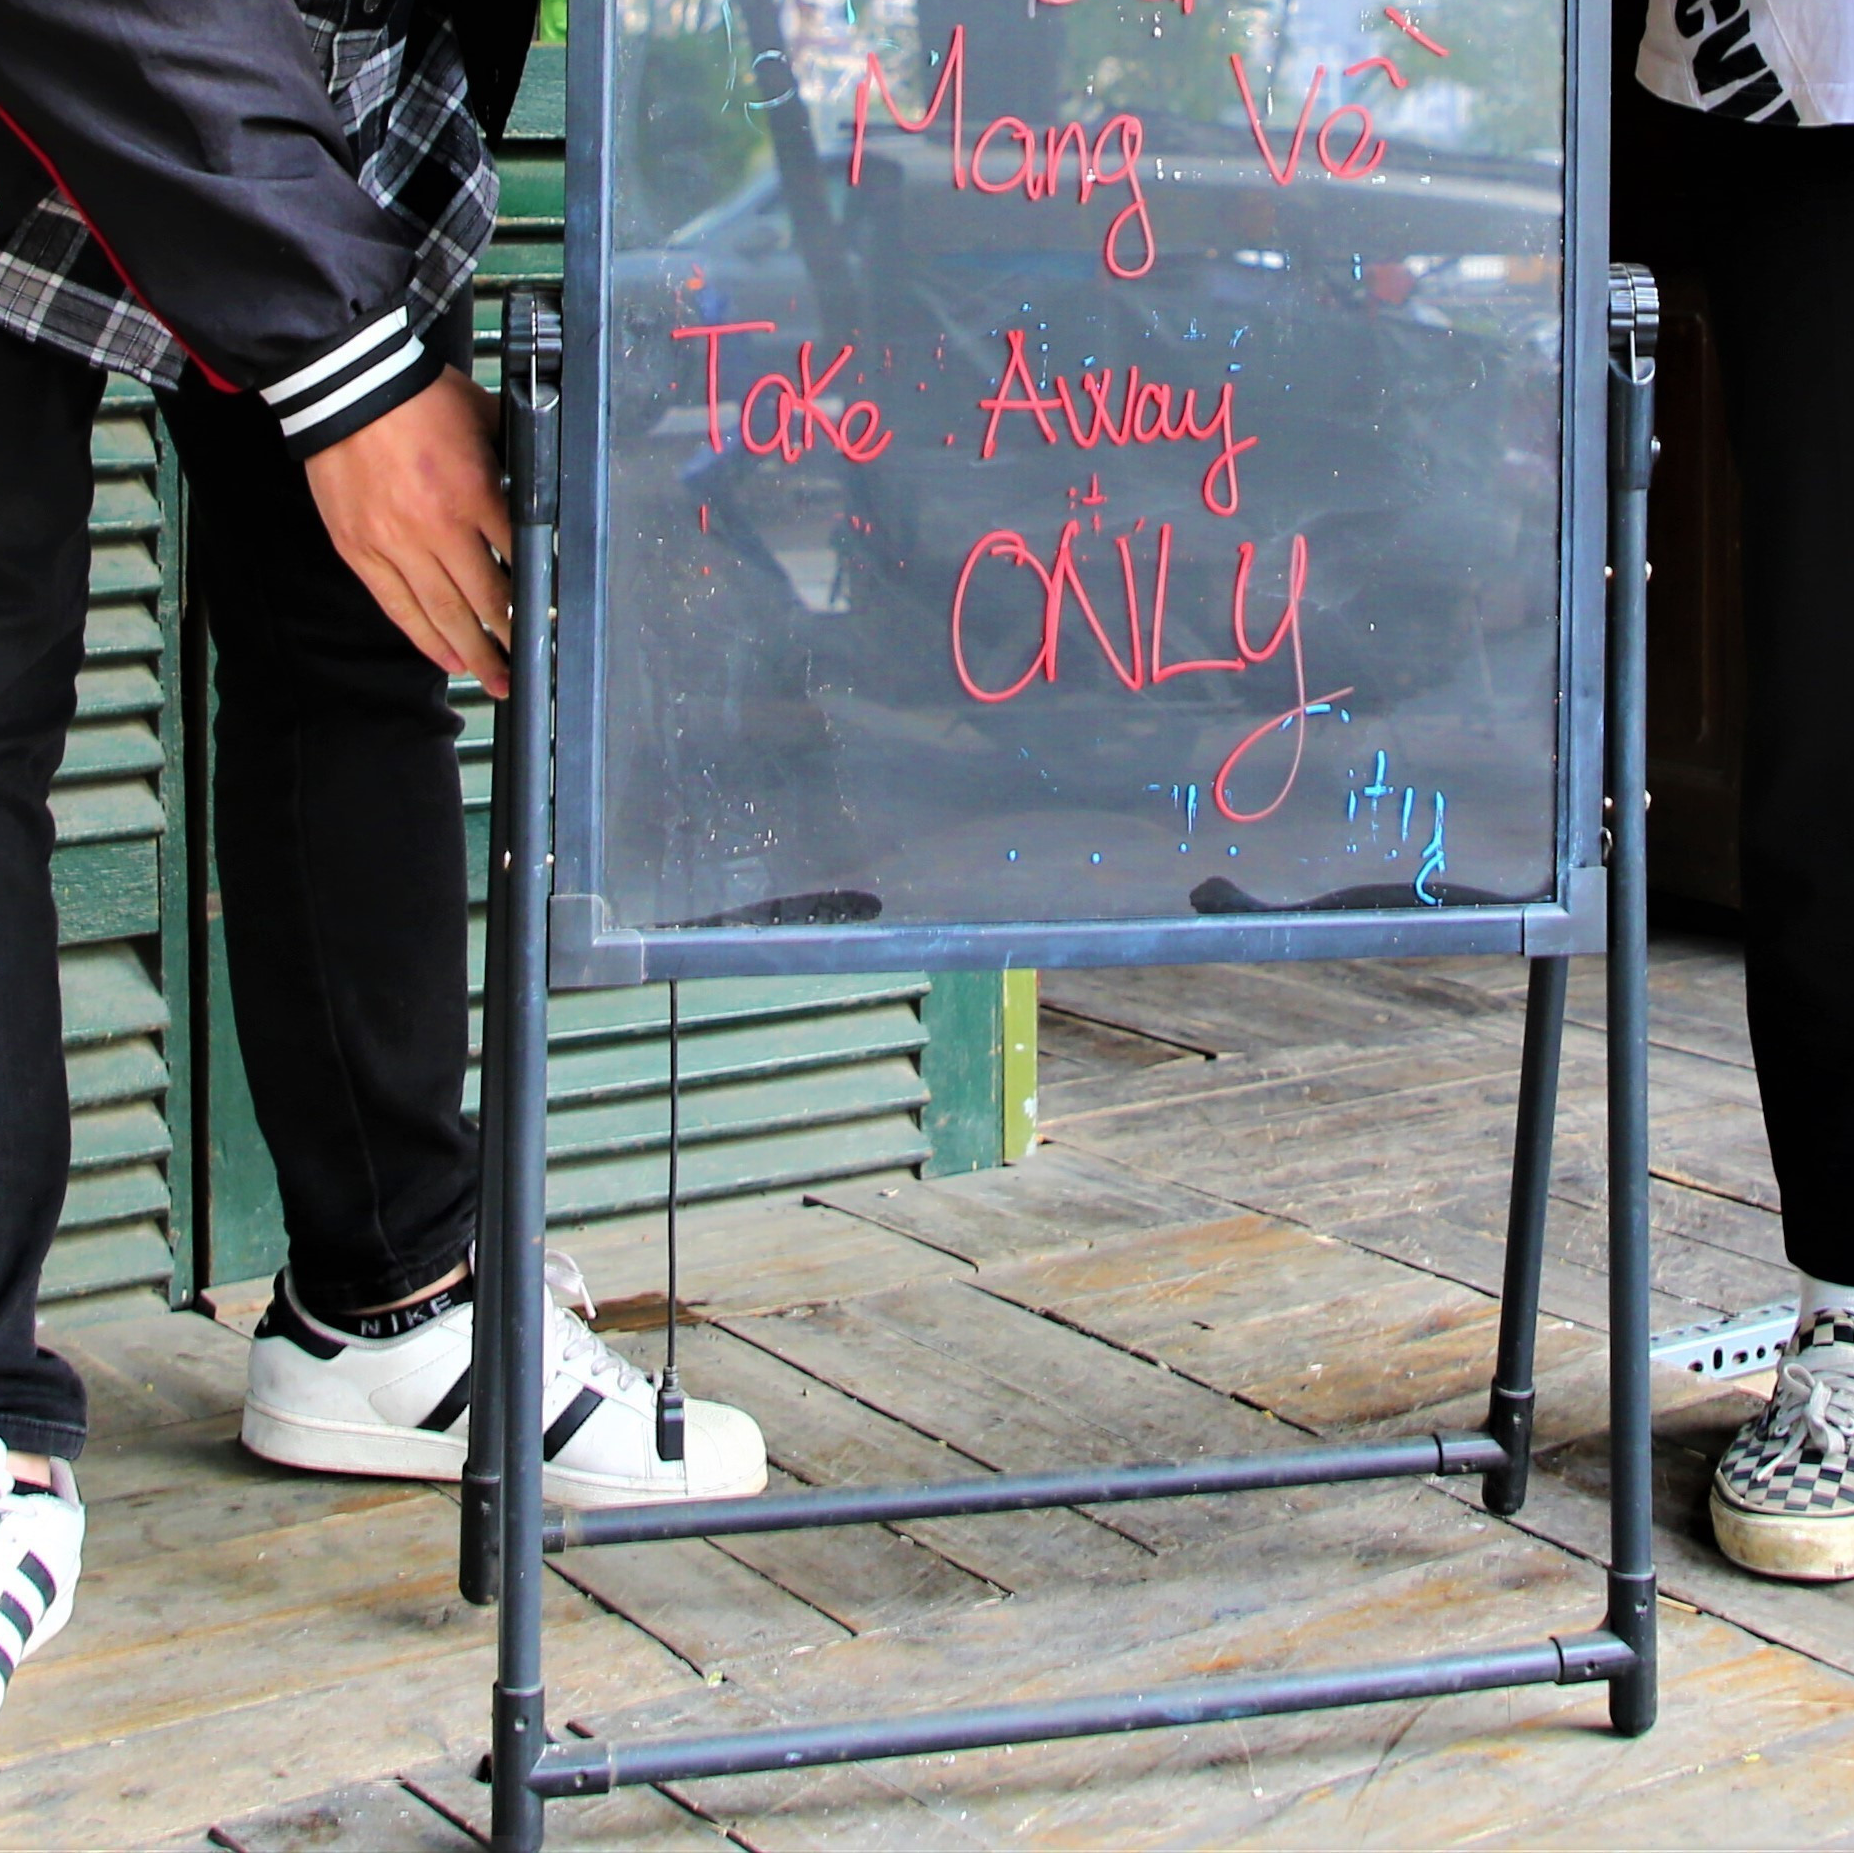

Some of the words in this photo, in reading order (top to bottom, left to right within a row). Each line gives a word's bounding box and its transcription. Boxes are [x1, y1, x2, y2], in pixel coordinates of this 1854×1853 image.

[851, 24, 1155, 278] Mang
[1232, 7, 1450, 185] Về
[979, 329, 1259, 516] Away
[360, 1292, 452, 1336] NIKE
